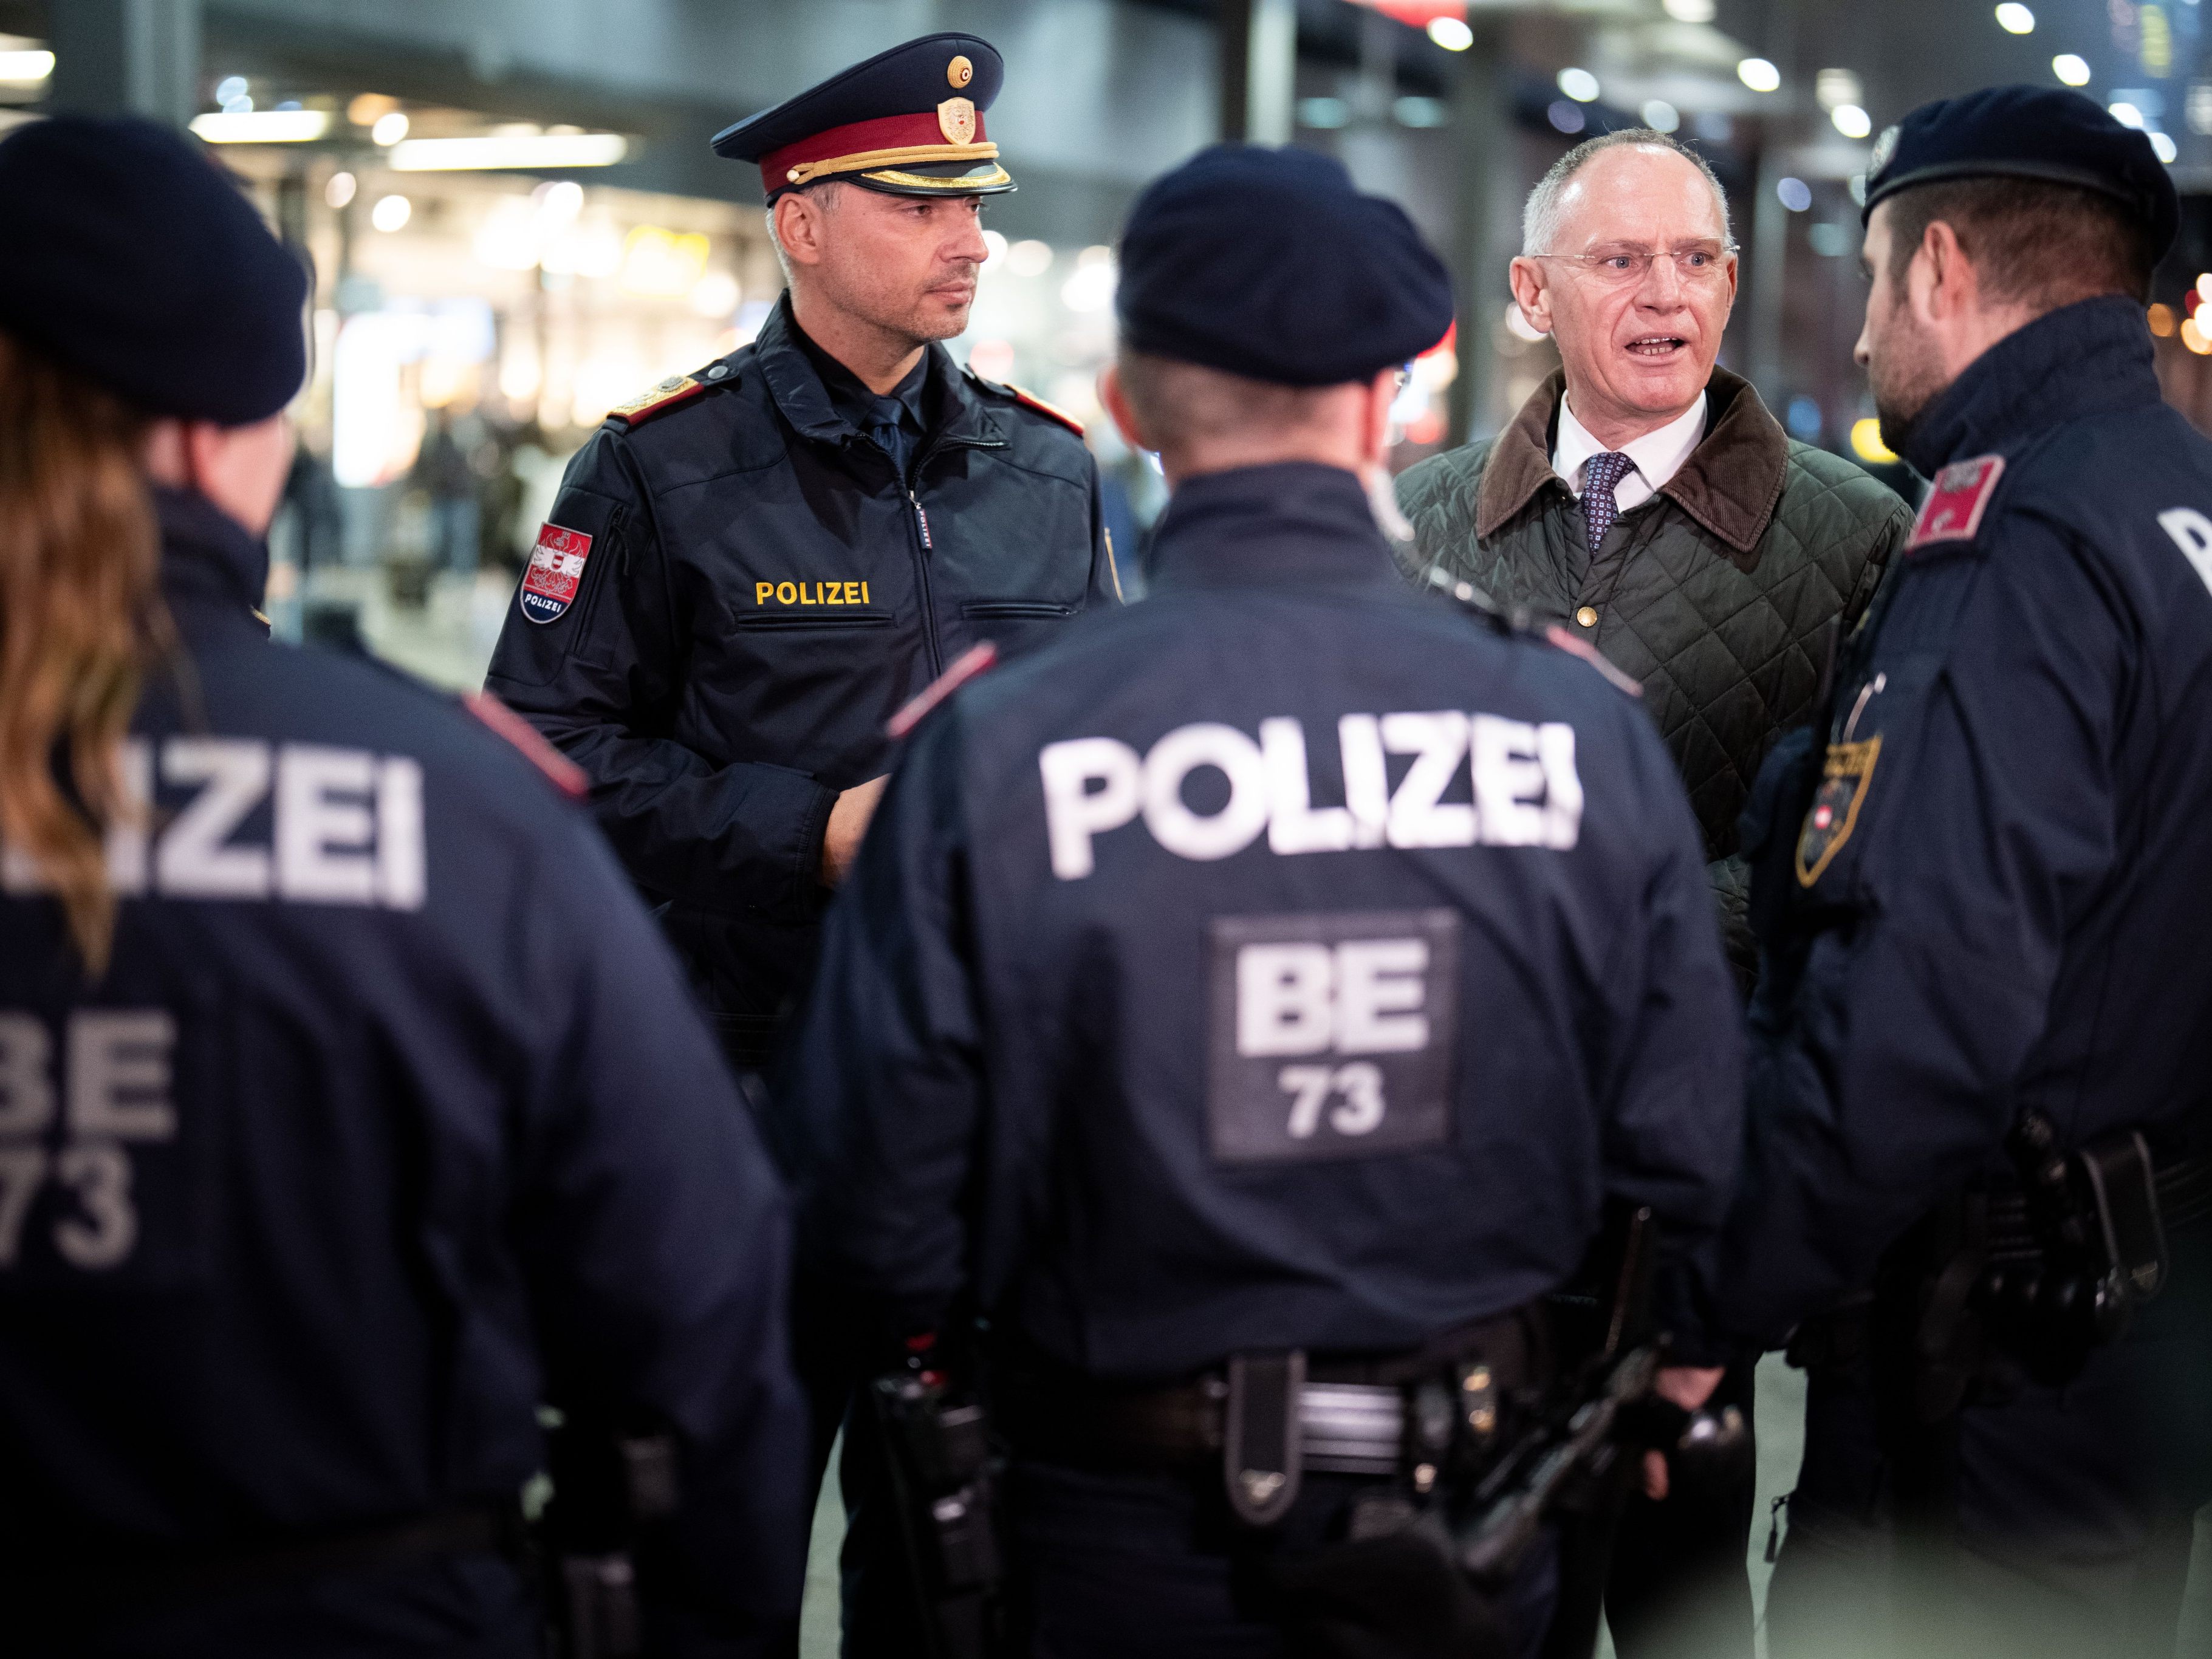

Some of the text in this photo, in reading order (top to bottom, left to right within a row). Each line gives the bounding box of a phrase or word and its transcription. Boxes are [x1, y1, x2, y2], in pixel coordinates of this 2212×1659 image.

[919, 511, 931, 547] POLIZEI
[524, 593, 561, 613] POLIZEI
[756, 581, 869, 605] POLIZEI
[1039, 710, 1584, 880] POLIZEI
[1236, 940, 1429, 1056] BE
[1278, 1062, 1385, 1138] 73
[0, 1148, 139, 1268] 73
